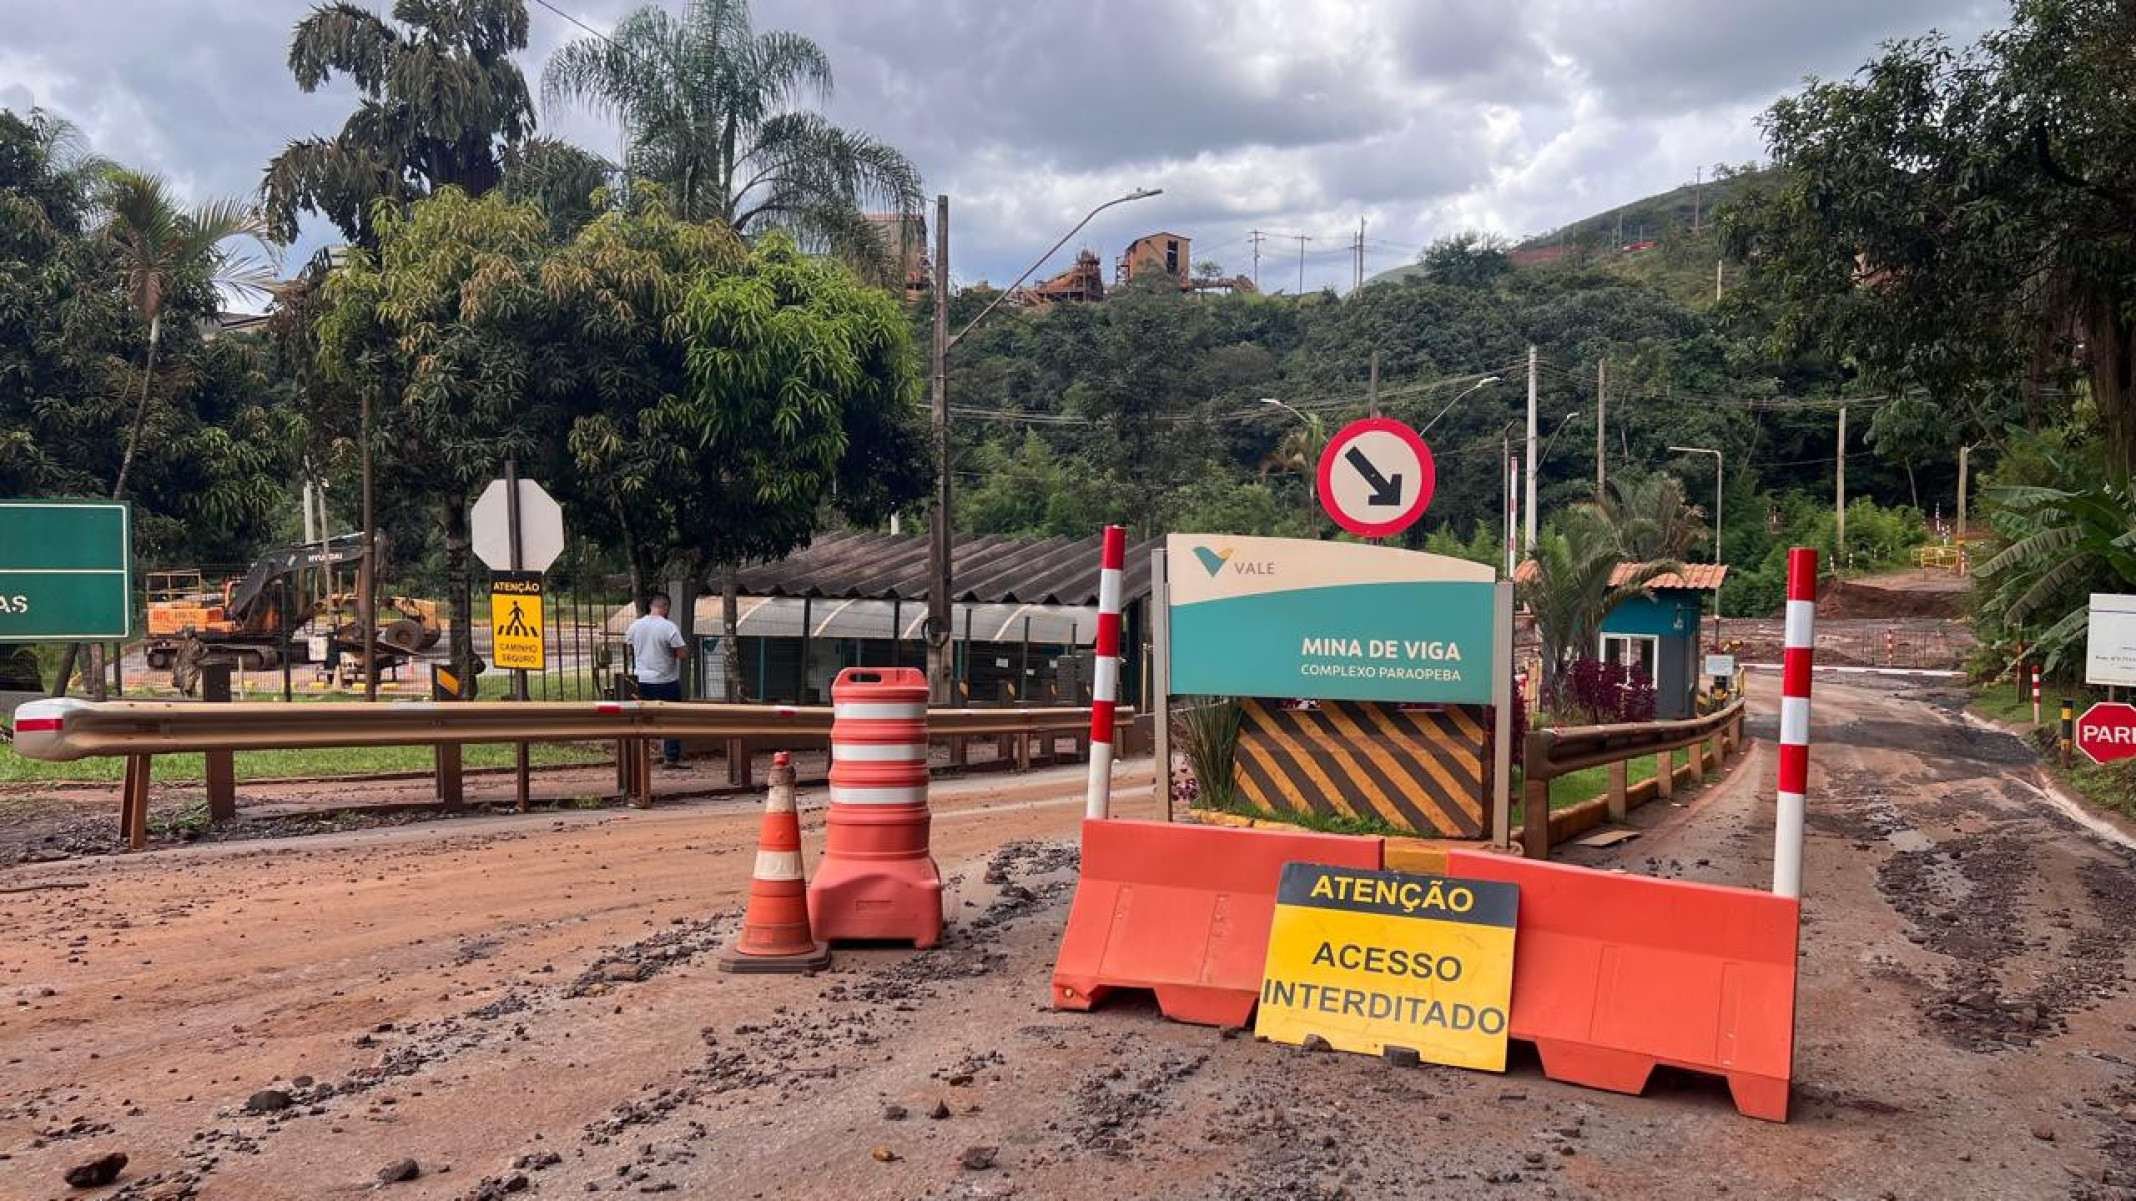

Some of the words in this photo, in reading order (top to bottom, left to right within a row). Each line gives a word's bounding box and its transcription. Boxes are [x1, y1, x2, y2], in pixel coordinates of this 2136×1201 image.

[1234, 562, 1275, 575] VALE
[493, 581, 540, 592] ATENÇÃO
[1302, 638, 1363, 657] MINA
[1369, 640, 1398, 658] DE
[1404, 640, 1462, 661] VIGA
[1301, 664, 1376, 678] COMPLEXO
[1379, 666, 1462, 681] PARAOPEBA
[1310, 875, 1475, 913] ATENÇÃO
[1312, 941, 1463, 981] ACESSO
[1262, 979, 1506, 1035] INTERDITADO
